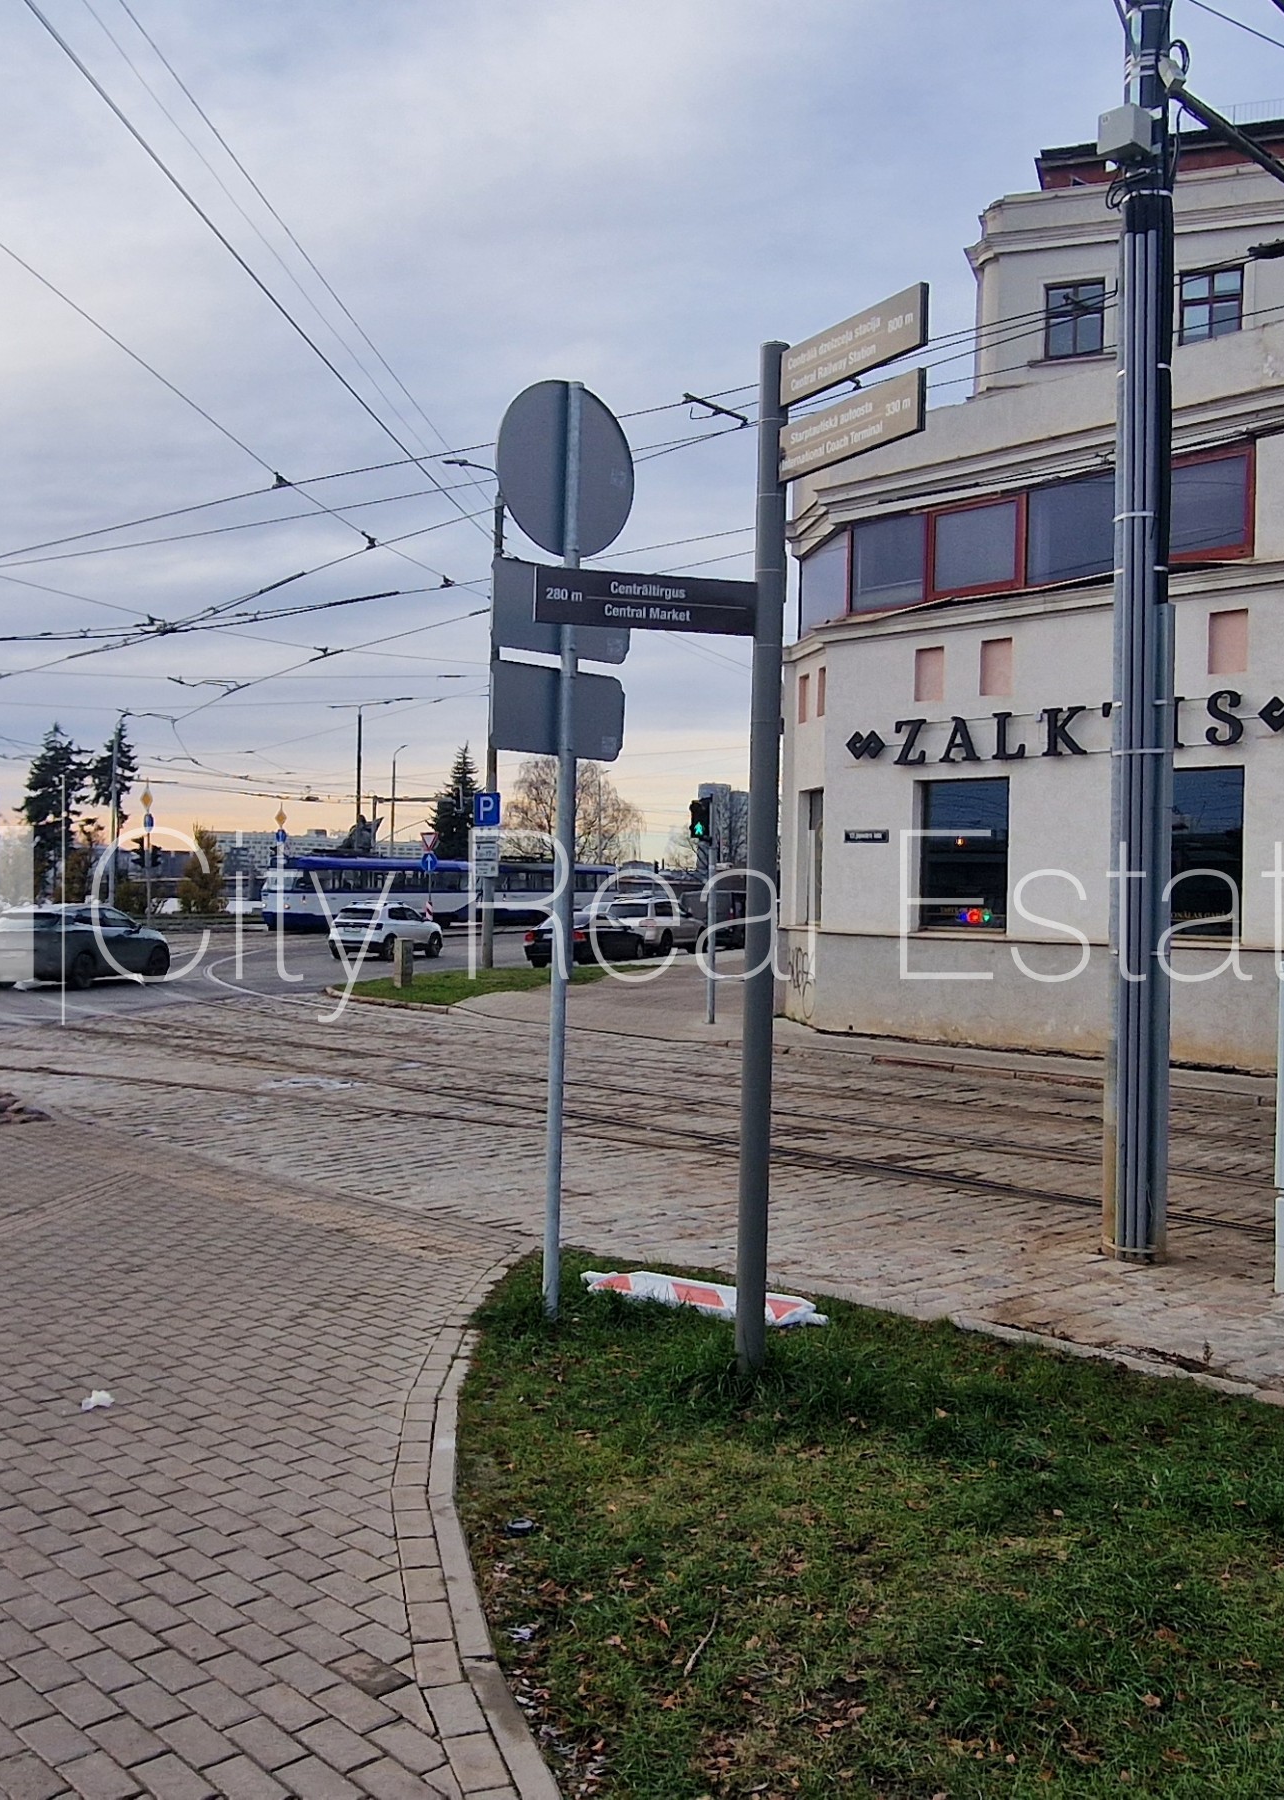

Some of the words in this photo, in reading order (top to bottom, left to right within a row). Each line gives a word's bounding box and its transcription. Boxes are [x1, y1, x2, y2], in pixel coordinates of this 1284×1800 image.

[854, 315, 881, 338] stacija
[887, 315, 903, 333] 800
[904, 312, 913, 325] m
[790, 369, 816, 391] Central
[817, 357, 847, 380] Railway
[848, 344, 876, 365] Station
[839, 402, 873, 426] autoosta
[885, 400, 900, 417] 330
[902, 397, 911, 410] m
[781, 443, 825, 471] International
[826, 434, 848, 454] Coach
[850, 420, 883, 443] Terminal
[546, 587, 568, 600] 280
[571, 591, 583, 602] m
[610, 581, 687, 600] Centrāltirgus
[604, 603, 646, 619] Central
[649, 607, 691, 622] Market
[894, 689, 1244, 766] ZALKIS
[479, 796, 494, 821] P
